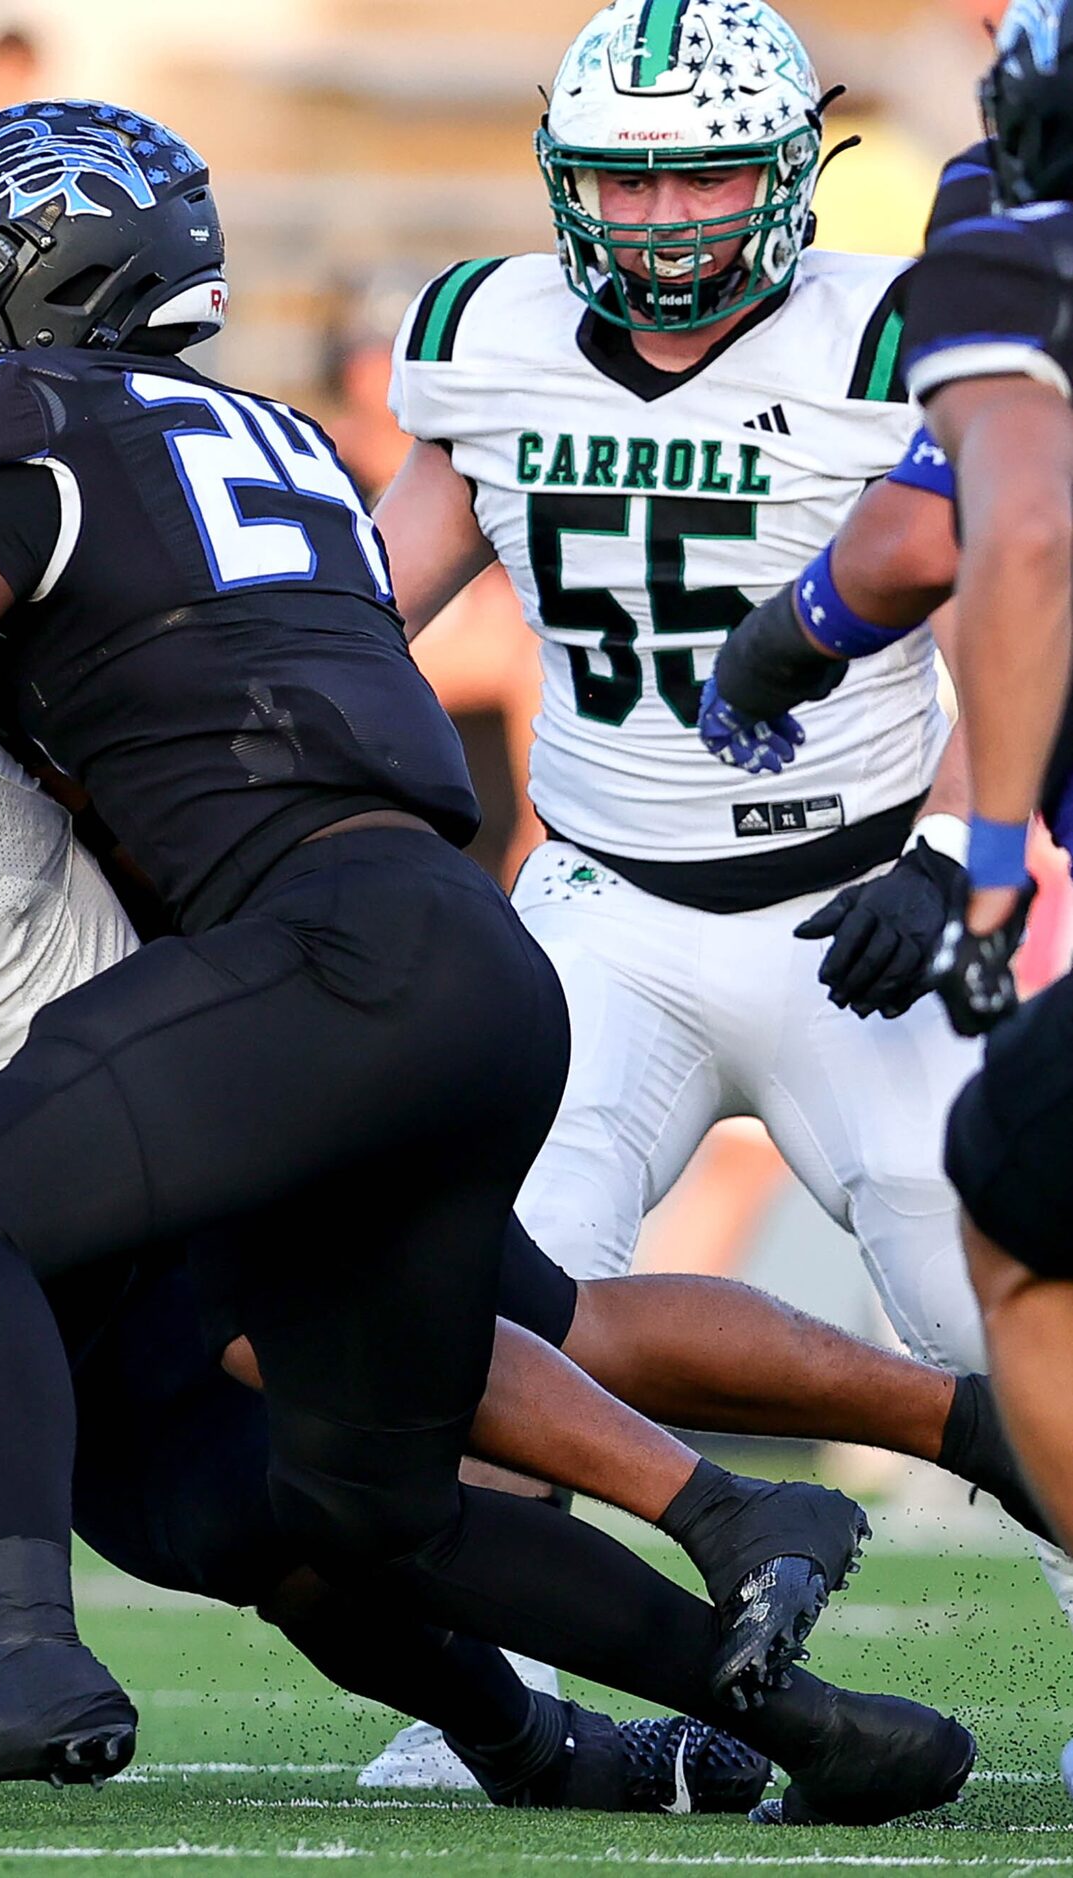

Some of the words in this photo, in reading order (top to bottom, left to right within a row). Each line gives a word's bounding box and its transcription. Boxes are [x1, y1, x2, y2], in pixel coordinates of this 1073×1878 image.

[646, 292, 692, 306] Rddell
[122, 371, 391, 604] 24
[517, 432, 771, 495] CARROLL
[527, 492, 758, 728] 55
[781, 813, 797, 827] XL
